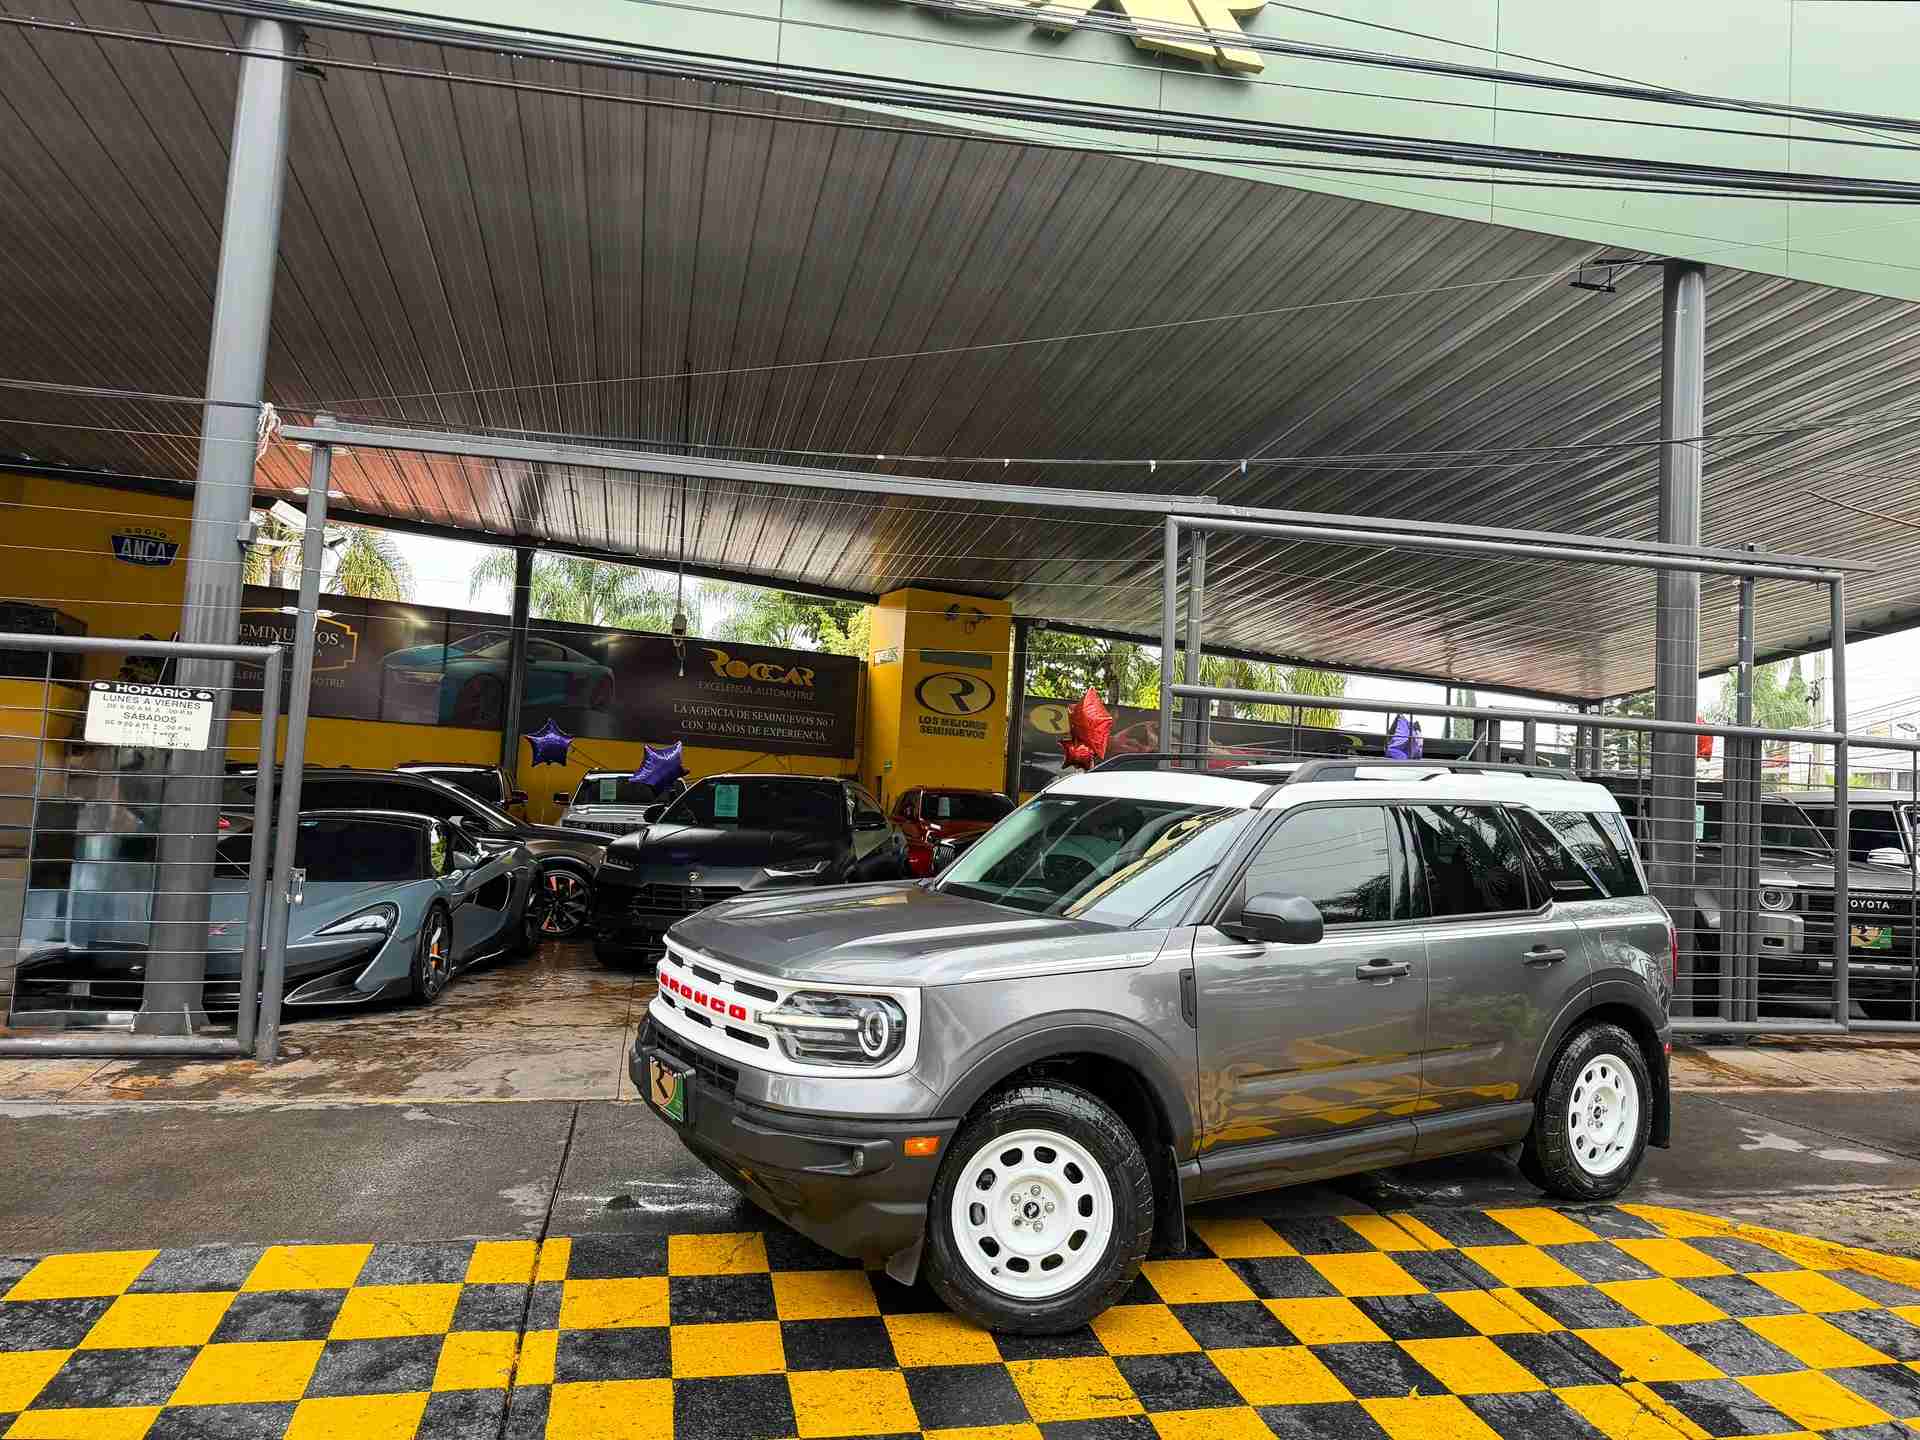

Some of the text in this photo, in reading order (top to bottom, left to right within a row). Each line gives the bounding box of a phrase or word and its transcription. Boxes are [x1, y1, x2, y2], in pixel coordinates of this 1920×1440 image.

[121, 538, 166, 561] ANCA
[240, 624, 339, 645] EMINUOS
[115, 684, 192, 698] HORARIO
[103, 693, 201, 710] LUNES A VIERNES
[123, 711, 177, 724] SABADOS
[674, 703, 688, 714] LA
[689, 705, 735, 719] AGENCIA
[736, 709, 751, 720] DE
[752, 711, 815, 726] SEMINUEVOS
[919, 715, 987, 730] LOS MEJORES
[680, 719, 704, 730] CON
[719, 720, 746, 735] AÑOS
[747, 725, 762, 736] DE
[763, 727, 826, 742] EXPERIENCIA
[919, 725, 985, 740] SEMINUEVOS
[1847, 898, 1891, 910] OYOTA
[660, 972, 747, 1021] BRONCO
